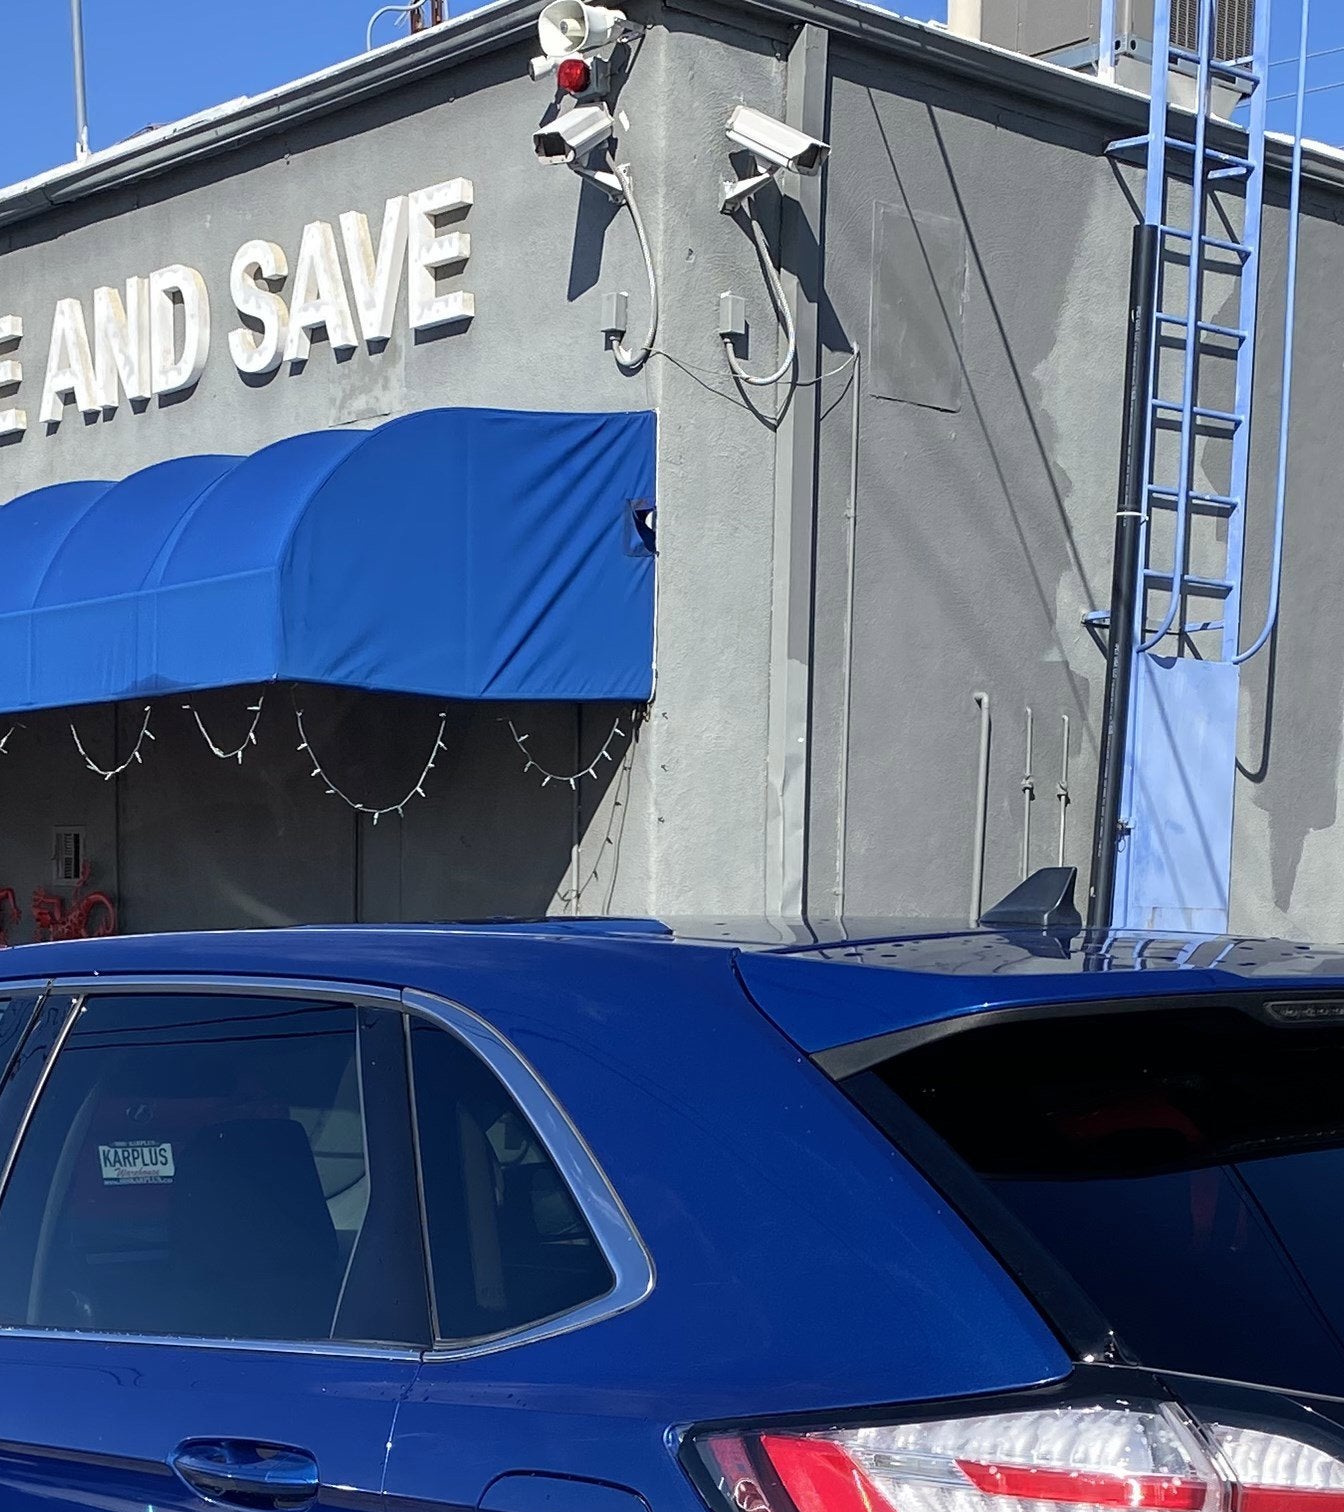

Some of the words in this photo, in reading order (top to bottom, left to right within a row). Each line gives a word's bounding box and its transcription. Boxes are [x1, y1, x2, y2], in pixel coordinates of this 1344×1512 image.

[39, 264, 210, 424] AND
[228, 176, 474, 374] SAVE
[102, 1148, 168, 1167] KARPLUS
